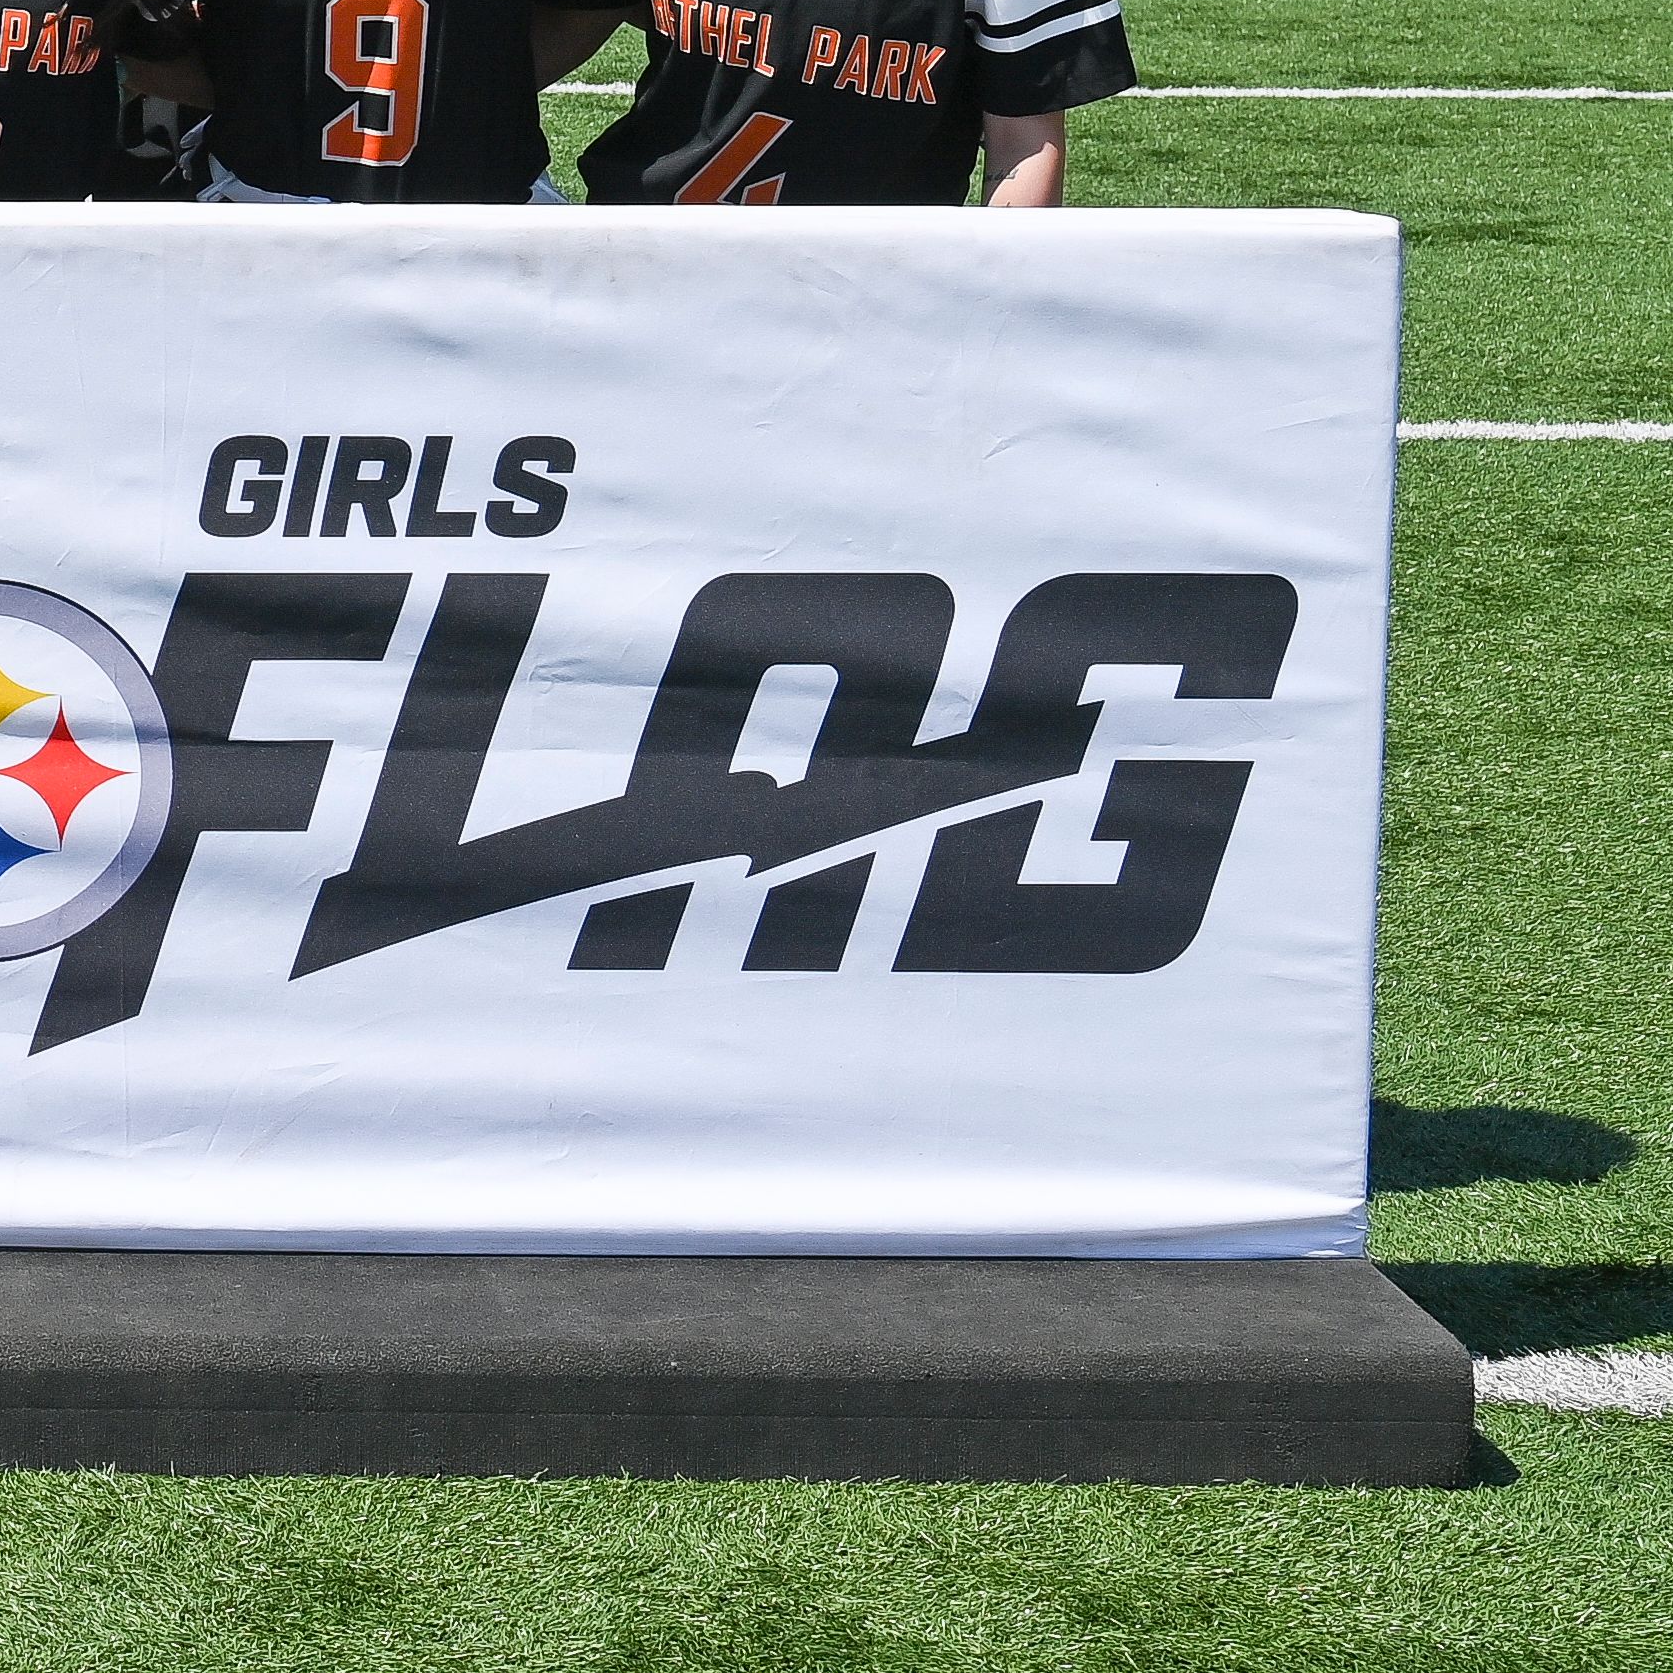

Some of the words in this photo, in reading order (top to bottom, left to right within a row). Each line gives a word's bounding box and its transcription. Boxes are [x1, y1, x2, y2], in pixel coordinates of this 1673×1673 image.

[801, 25, 946, 105] PARK
[674, 111, 793, 205] 4
[197, 435, 576, 538] GIRLS
[27, 572, 1299, 1057] FLAG
